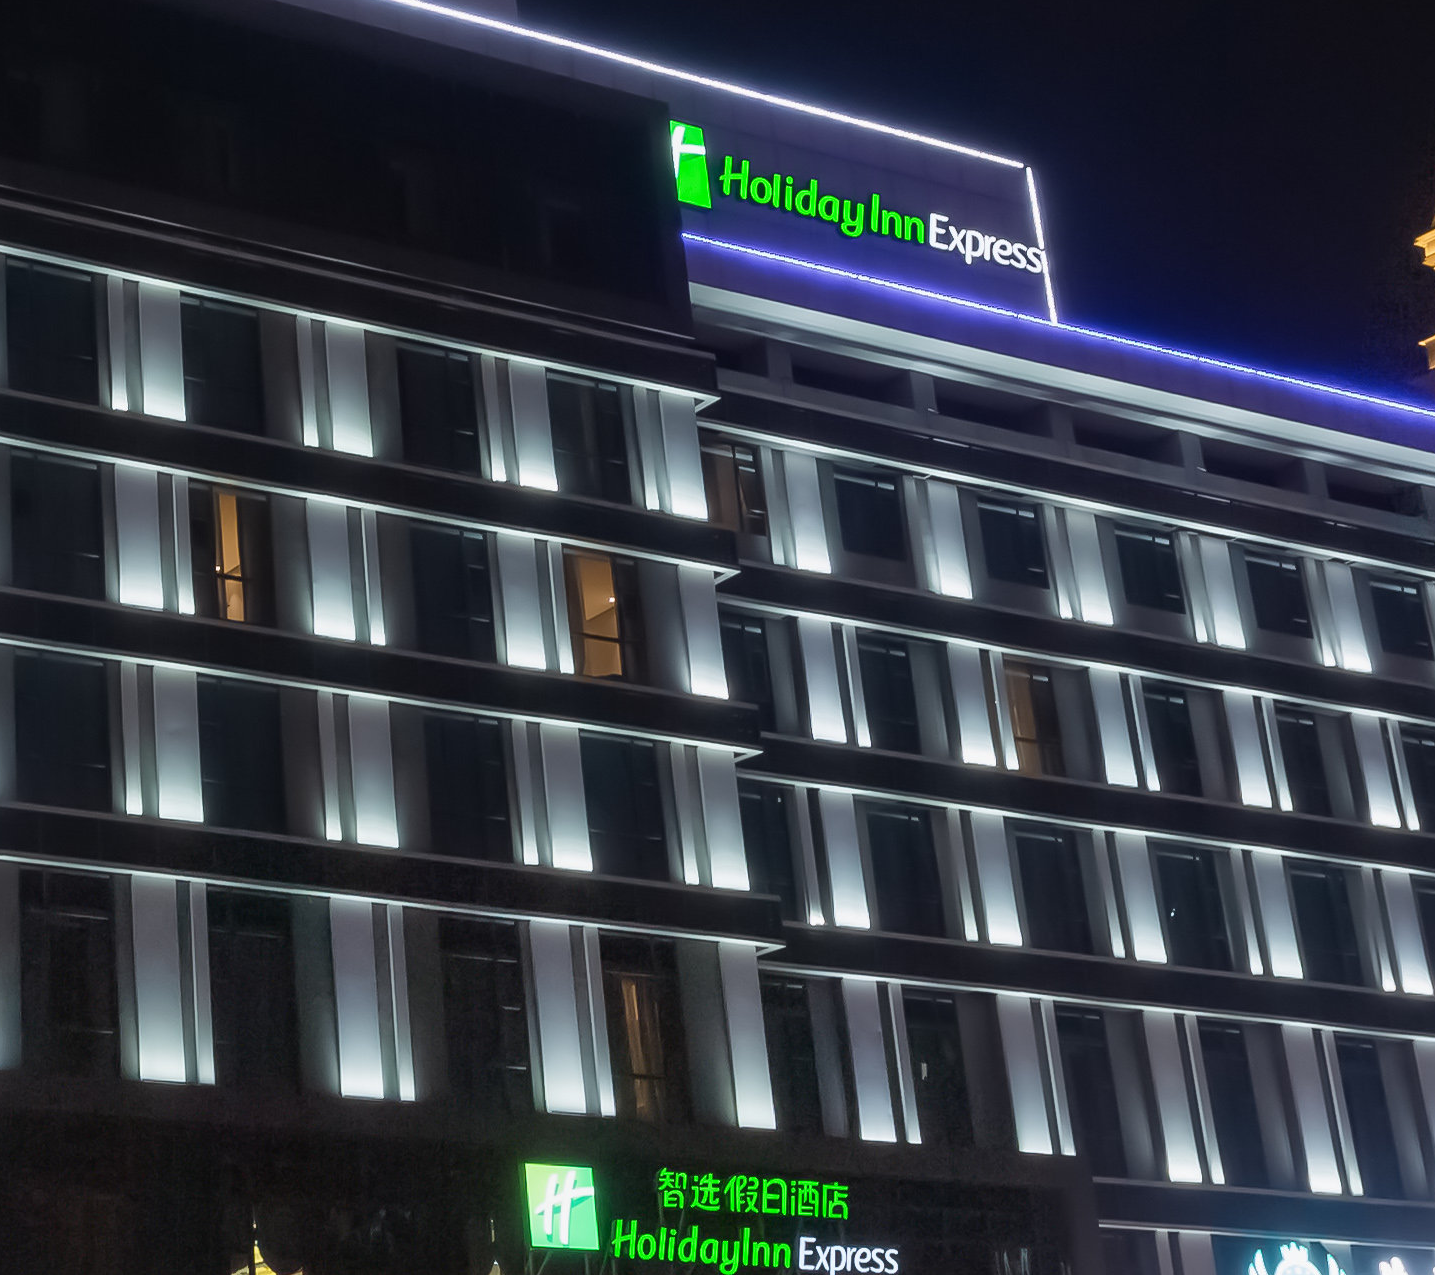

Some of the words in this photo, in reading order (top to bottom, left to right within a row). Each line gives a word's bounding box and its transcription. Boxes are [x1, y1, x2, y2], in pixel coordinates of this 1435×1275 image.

[719, 155, 864, 237] Holiday
[870, 193, 925, 243] Inn
[929, 213, 1044, 273] Express
[658, 1167, 848, 1220] 智选假日酒店
[611, 1219, 740, 1275] Holiday
[742, 1227, 791, 1269] Inn
